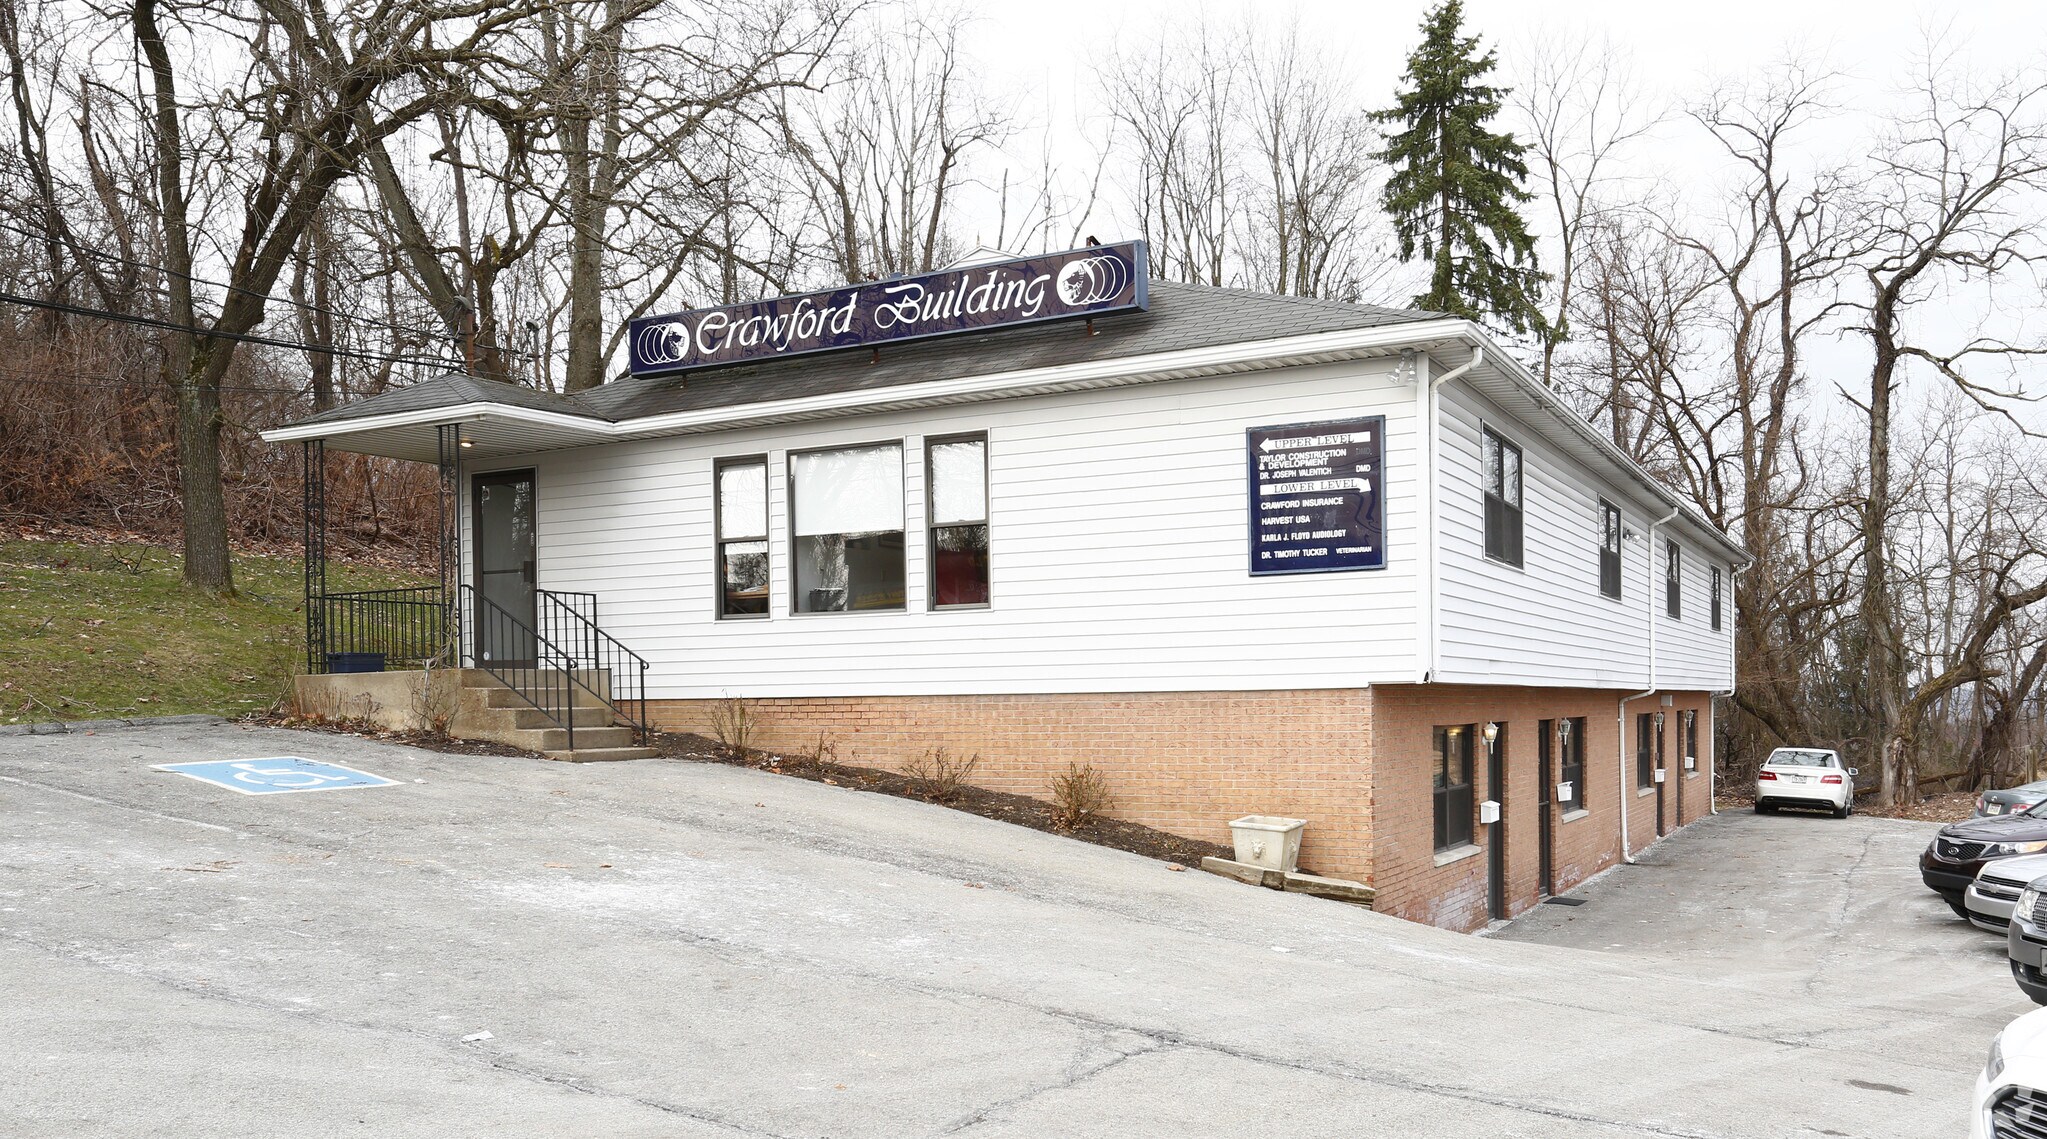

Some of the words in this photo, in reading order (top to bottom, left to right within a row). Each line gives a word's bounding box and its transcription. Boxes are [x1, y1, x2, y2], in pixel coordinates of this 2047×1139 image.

[696, 293, 858, 355] Crawford
[874, 269, 1051, 328] Building
[1275, 438, 1311, 448] UPPER
[1317, 434, 1354, 445] LEVEL
[1259, 453, 1286, 463] TAYLOR
[1288, 449, 1346, 460] CONSTRUCTION
[1268, 458, 1328, 469] DEVELOPMENT
[1259, 472, 1270, 480] DR.
[1272, 469, 1296, 478] JOSEPH
[1299, 467, 1332, 477] VALENTICH
[1356, 464, 1371, 472] DMD
[1274, 482, 1314, 493] LOWER
[1320, 479, 1357, 490] LEVEL
[1260, 500, 1300, 510] CRAWFORD
[1302, 497, 1344, 507] INSURANCE
[1261, 516, 1293, 525] HARVEST
[1296, 515, 1310, 523] USA
[1261, 533, 1281, 542] KARLA
[1283, 533, 1289, 541] J.
[1291, 532, 1310, 540] FLOYD
[1312, 529, 1346, 539] AUDIOLOGY
[1261, 551, 1272, 559] DR.
[1274, 549, 1300, 558] TIMOTHY
[1302, 548, 1328, 557] TUCKER
[1336, 546, 1372, 554] VETERINARIAN
